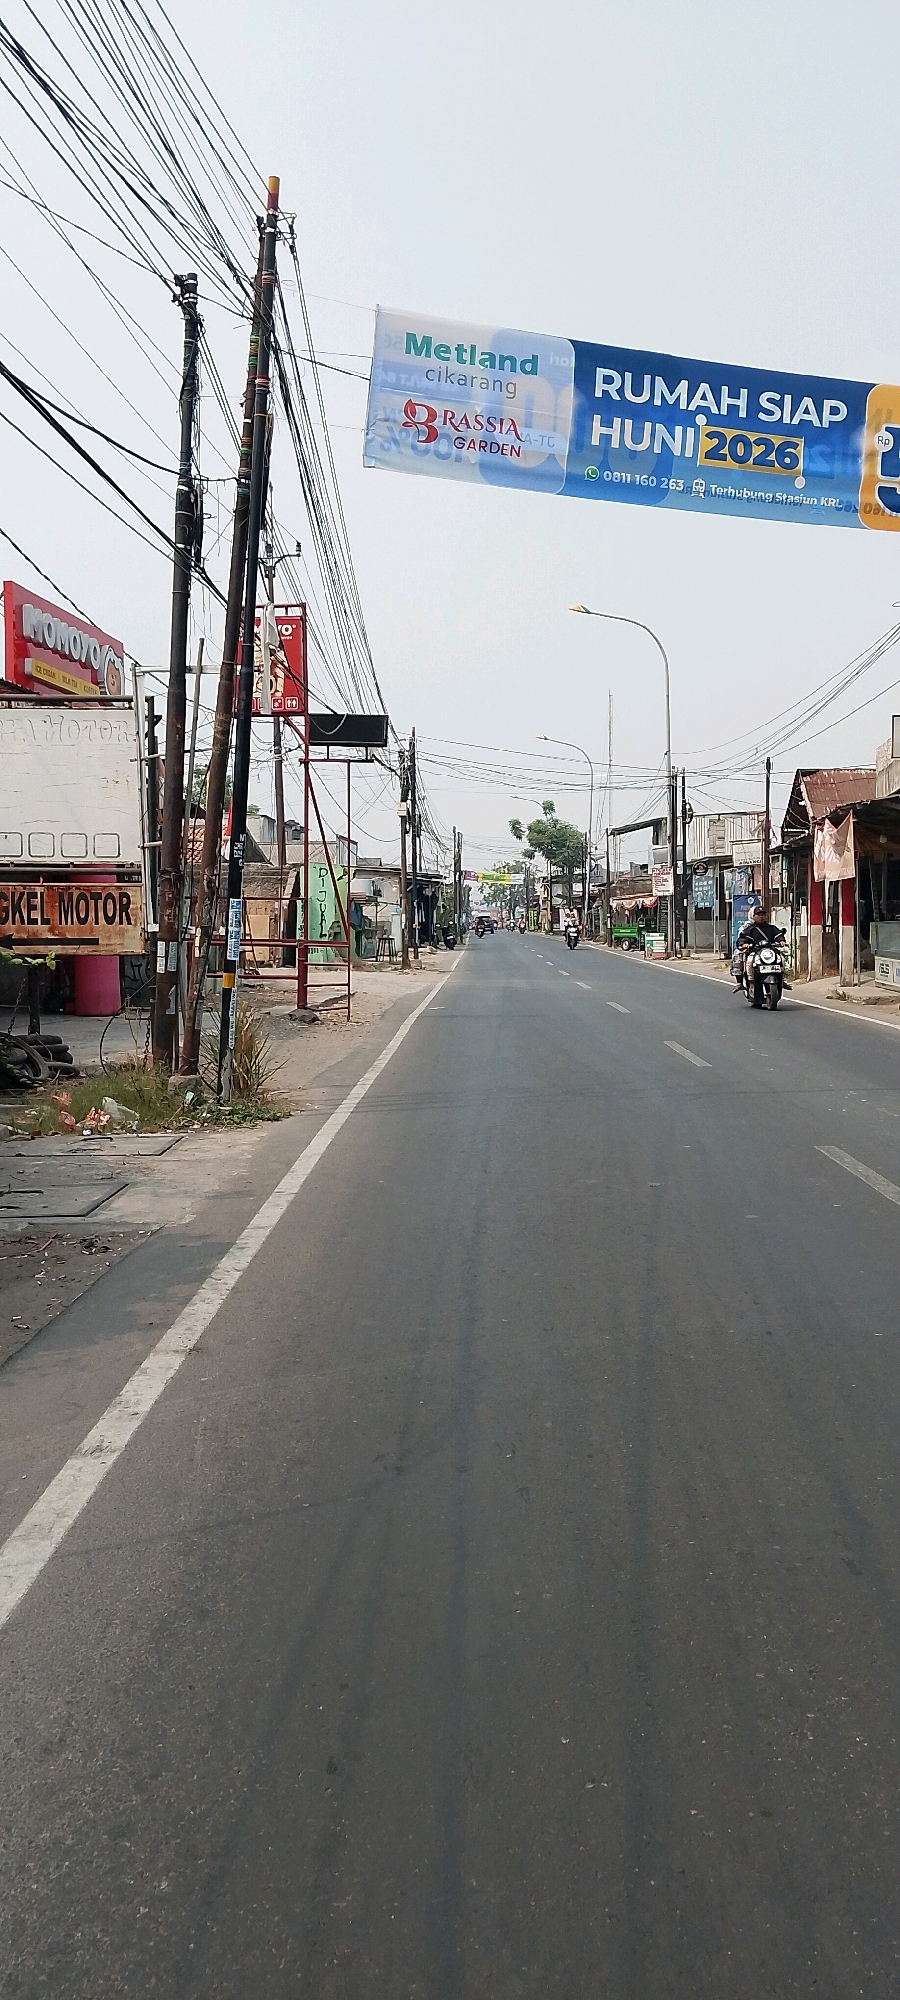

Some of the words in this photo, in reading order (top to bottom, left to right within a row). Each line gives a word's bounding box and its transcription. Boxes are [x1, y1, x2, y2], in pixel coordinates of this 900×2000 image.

[405, 332, 539, 376] Metland
[425, 366, 518, 399] cikarang
[595, 367, 748, 418] RUMAH
[757, 391, 848, 428] SIAP
[402, 398, 525, 444] BRASSIA
[453, 436, 522, 458] GARDEN
[591, 414, 695, 458] HUNI
[704, 430, 800, 470] 2026
[877, 435, 890, 447] Rp
[603, 470, 631, 484] 0811
[635, 474, 657, 487] 160
[660, 477, 685, 491] 263
[710, 484, 773, 503] Terhubung
[775, 491, 818, 507] Stasiun
[820, 496, 842, 508] KRL
[22, 604, 100, 671] MOMOYO
[0, 892, 51, 926] GKEL
[58, 892, 133, 926] MOTOR
